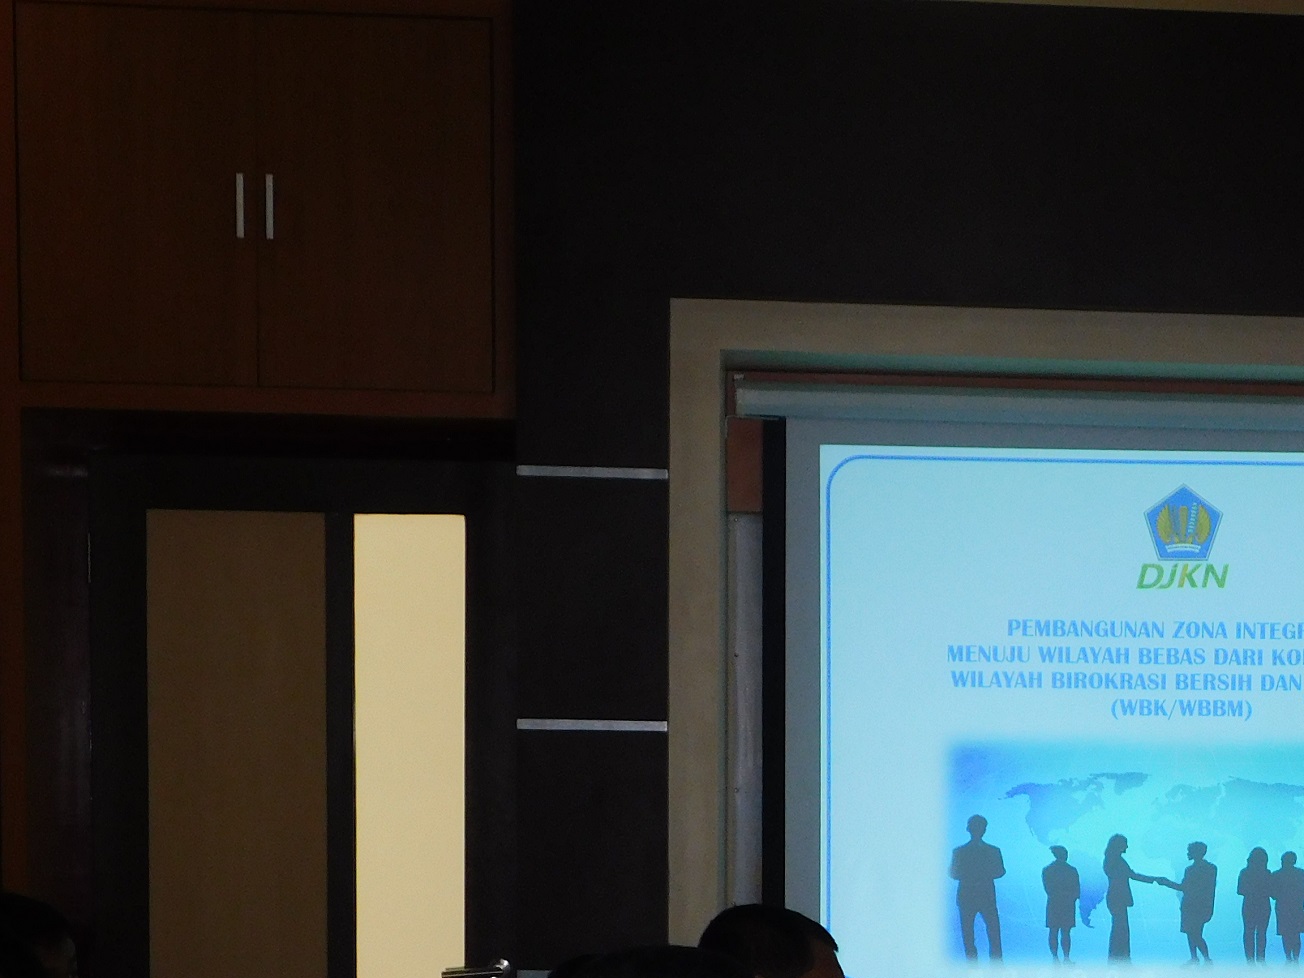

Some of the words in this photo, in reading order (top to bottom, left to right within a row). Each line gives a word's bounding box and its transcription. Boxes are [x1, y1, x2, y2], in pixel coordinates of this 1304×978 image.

[1136, 564, 1229, 590] DJKN
[1007, 618, 1165, 639] PEMBANGUNAN
[1172, 620, 1227, 640] ZONA
[947, 644, 1030, 664] MENUJU
[1038, 645, 1130, 665] WILAYAH
[1138, 647, 1206, 666] BEBAS
[1213, 647, 1264, 667] DARI
[950, 669, 1043, 689] WILAYAH
[1051, 671, 1167, 691] BIROKRASI
[1175, 673, 1252, 692] BERSIH
[1260, 673, 1302, 692] DAN
[1111, 698, 1253, 722] (WBK/WBBM)
